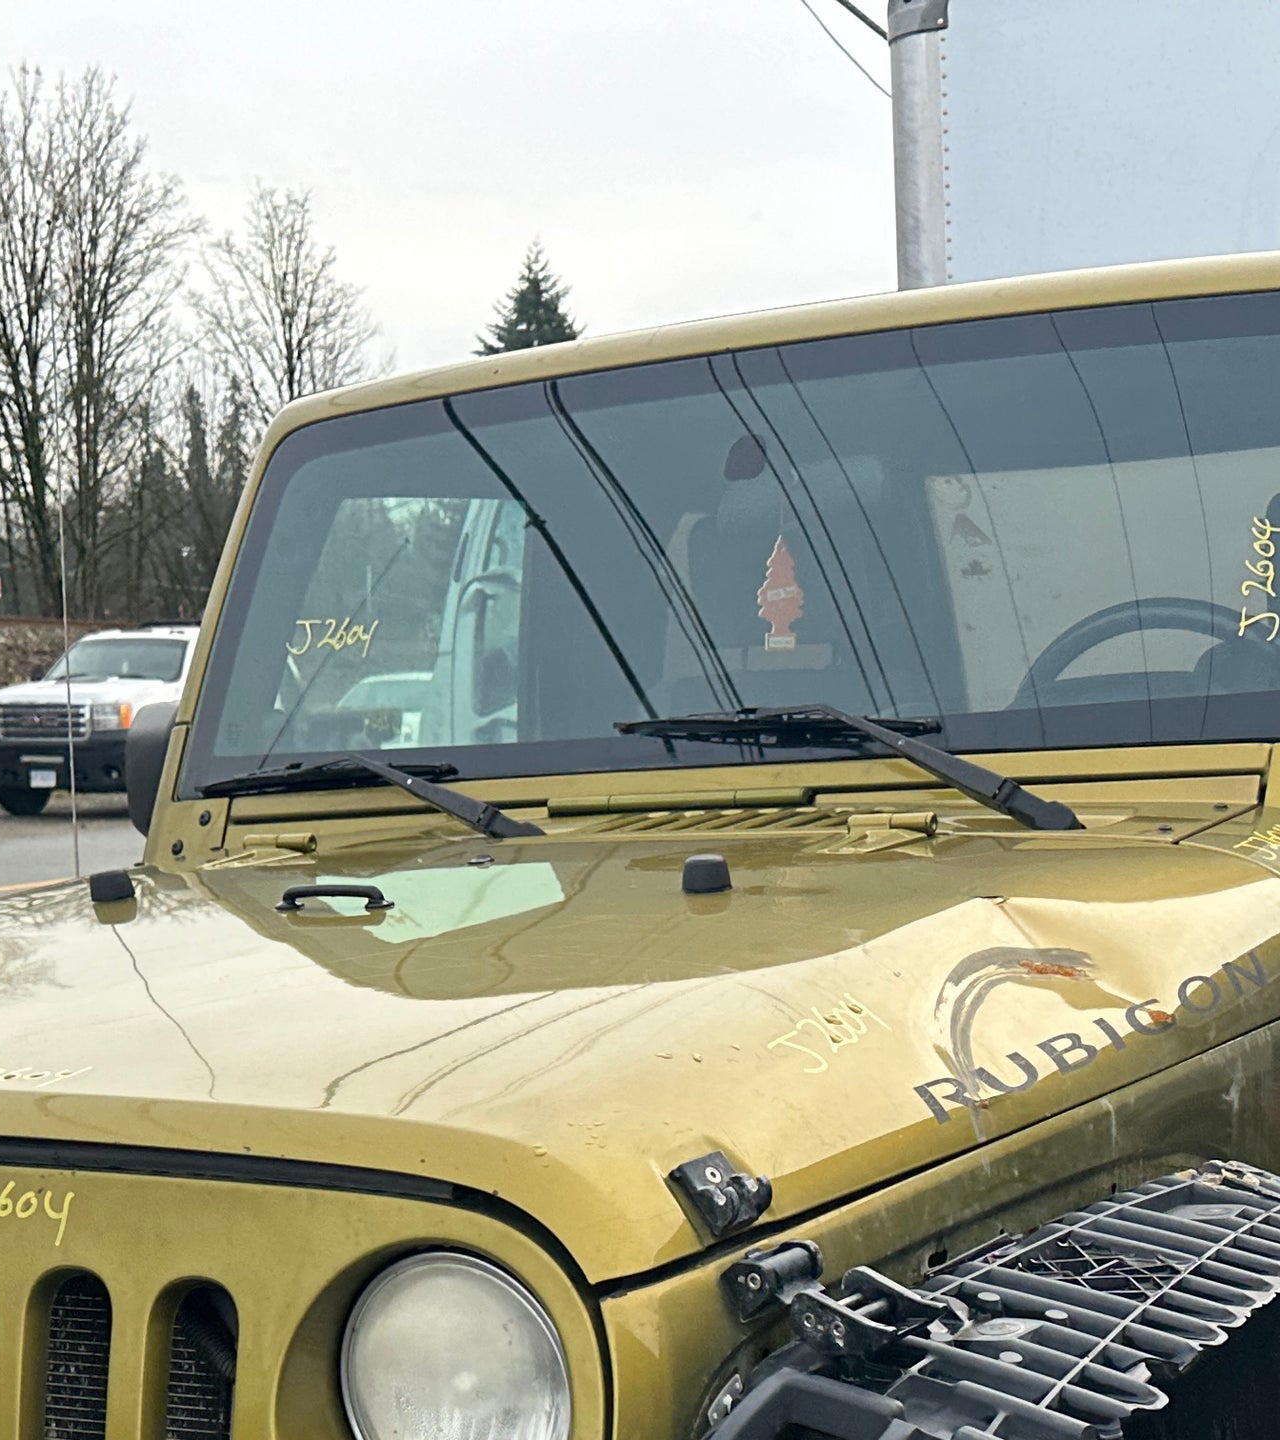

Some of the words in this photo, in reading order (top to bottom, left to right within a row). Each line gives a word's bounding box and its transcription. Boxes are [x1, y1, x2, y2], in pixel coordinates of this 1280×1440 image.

[286, 616, 380, 658] J2604
[767, 992, 893, 1074] J2604
[913, 949, 1269, 1126] RUBICON
